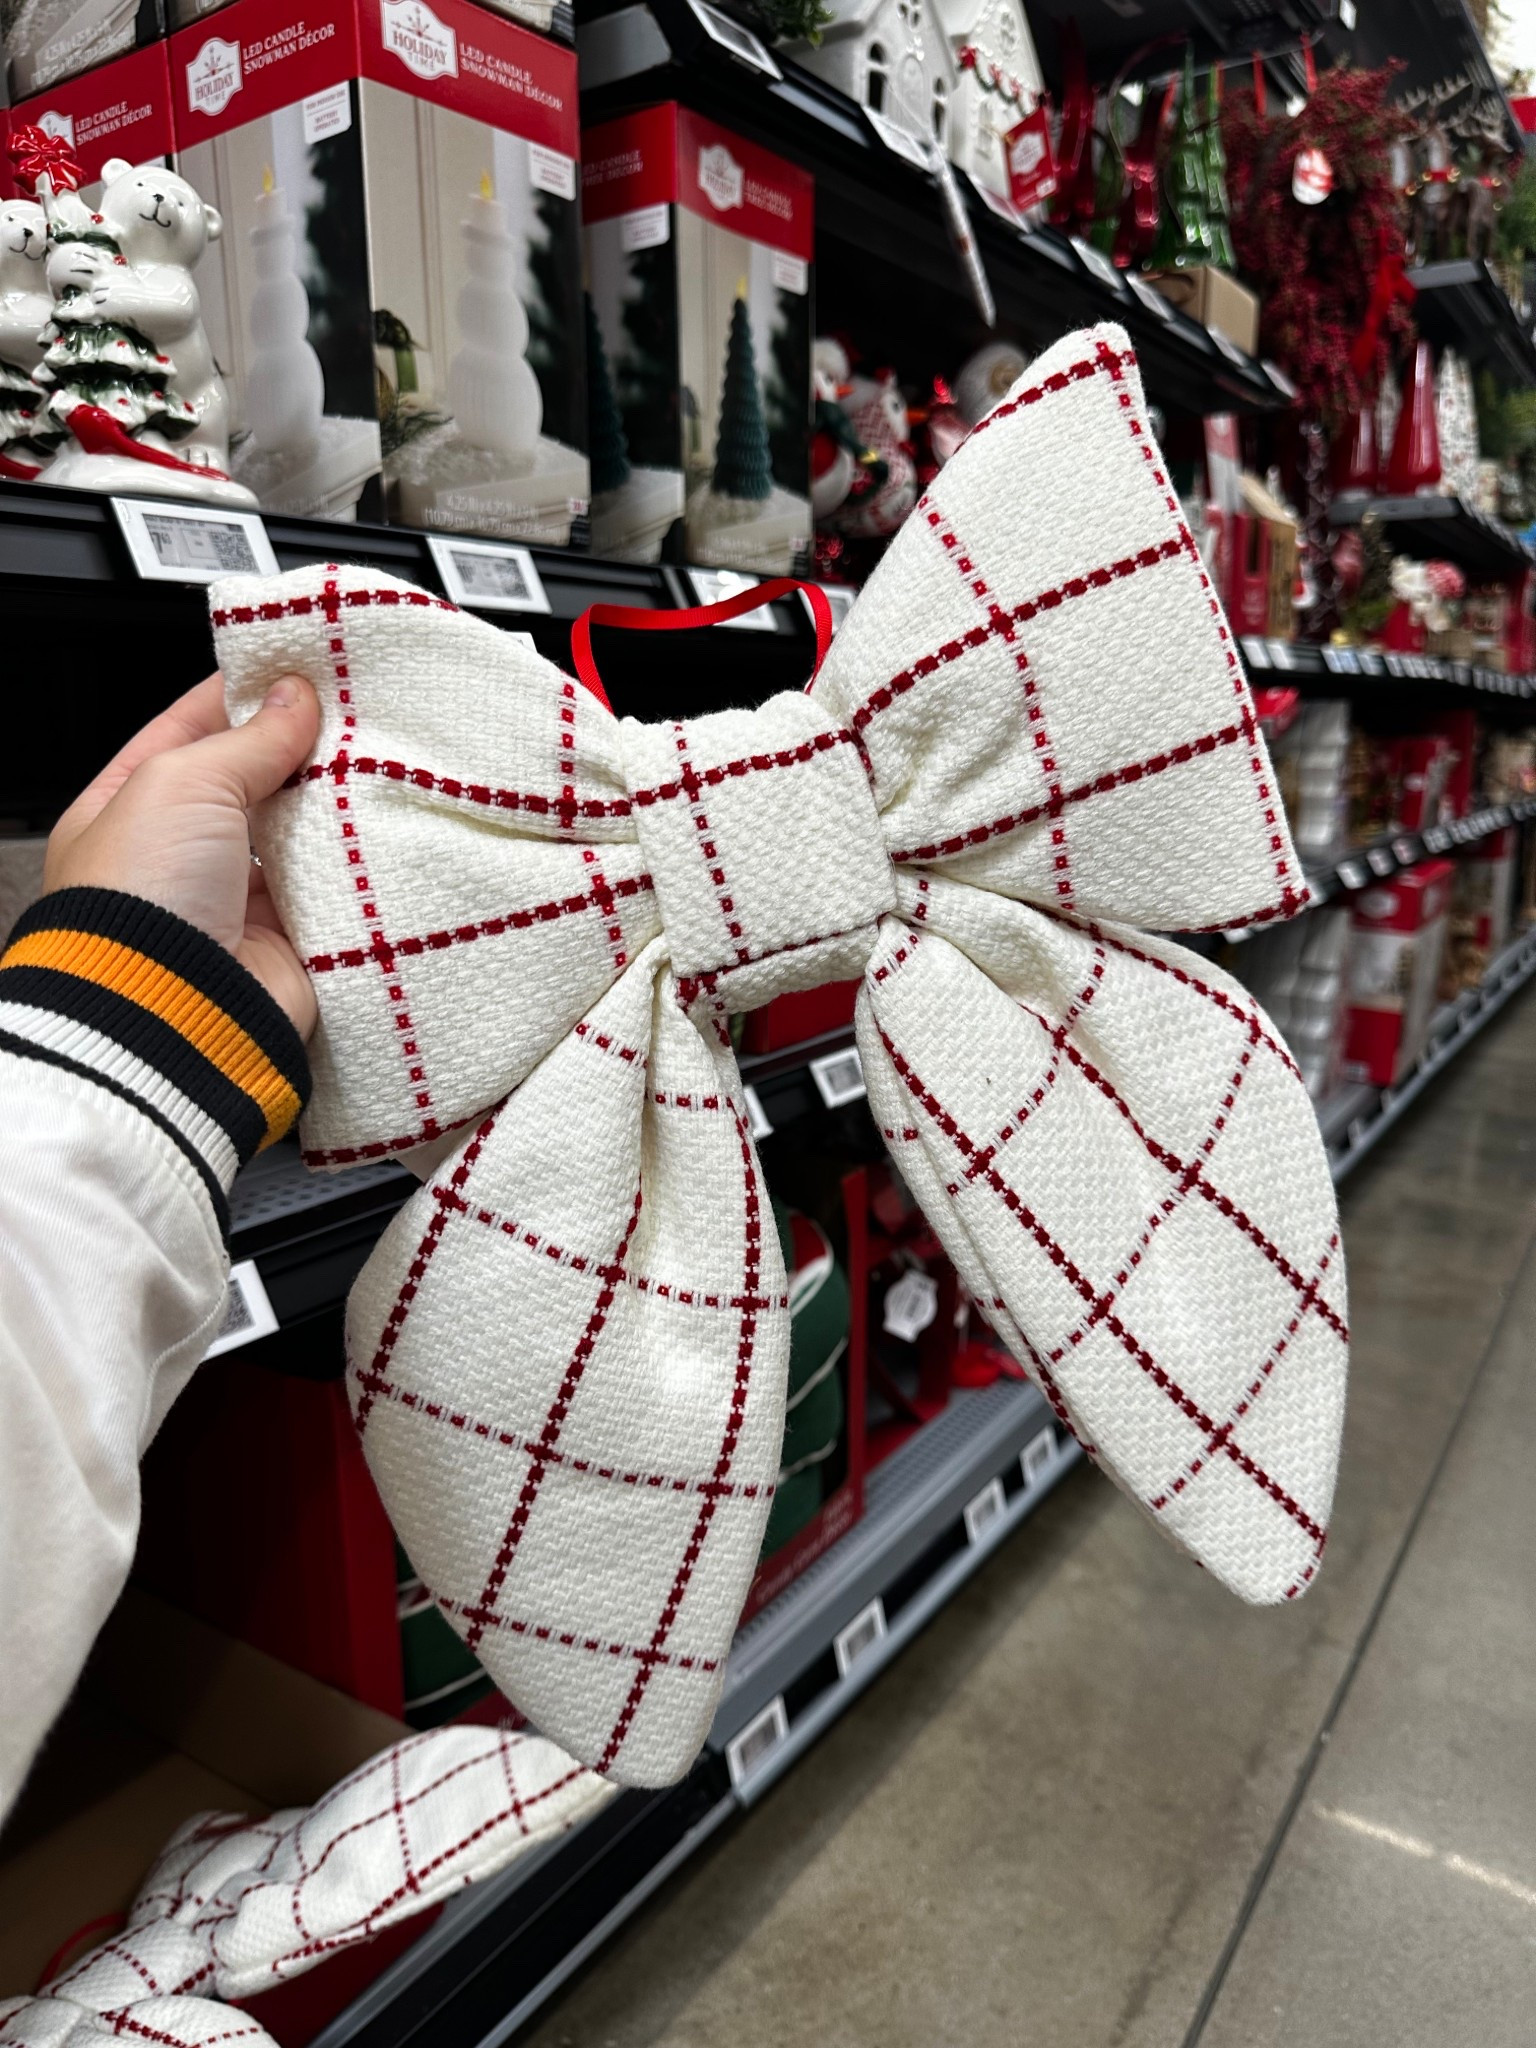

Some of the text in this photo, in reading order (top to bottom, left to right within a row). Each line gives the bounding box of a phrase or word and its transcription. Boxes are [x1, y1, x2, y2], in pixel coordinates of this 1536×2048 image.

[243, 21, 305, 60] LED CANDLE
[244, 23, 336, 75] SNOWMAN DÉCOR
[392, 30, 447, 65] HOLIDAY
[460, 42, 533, 85] LED CANDLE
[460, 57, 524, 94] SNOWMAN
[195, 72, 234, 102] HOLIDAY
[75, 101, 128, 132] LED CANDLE
[76, 104, 152, 146] SNOWMAN DÉCOR
